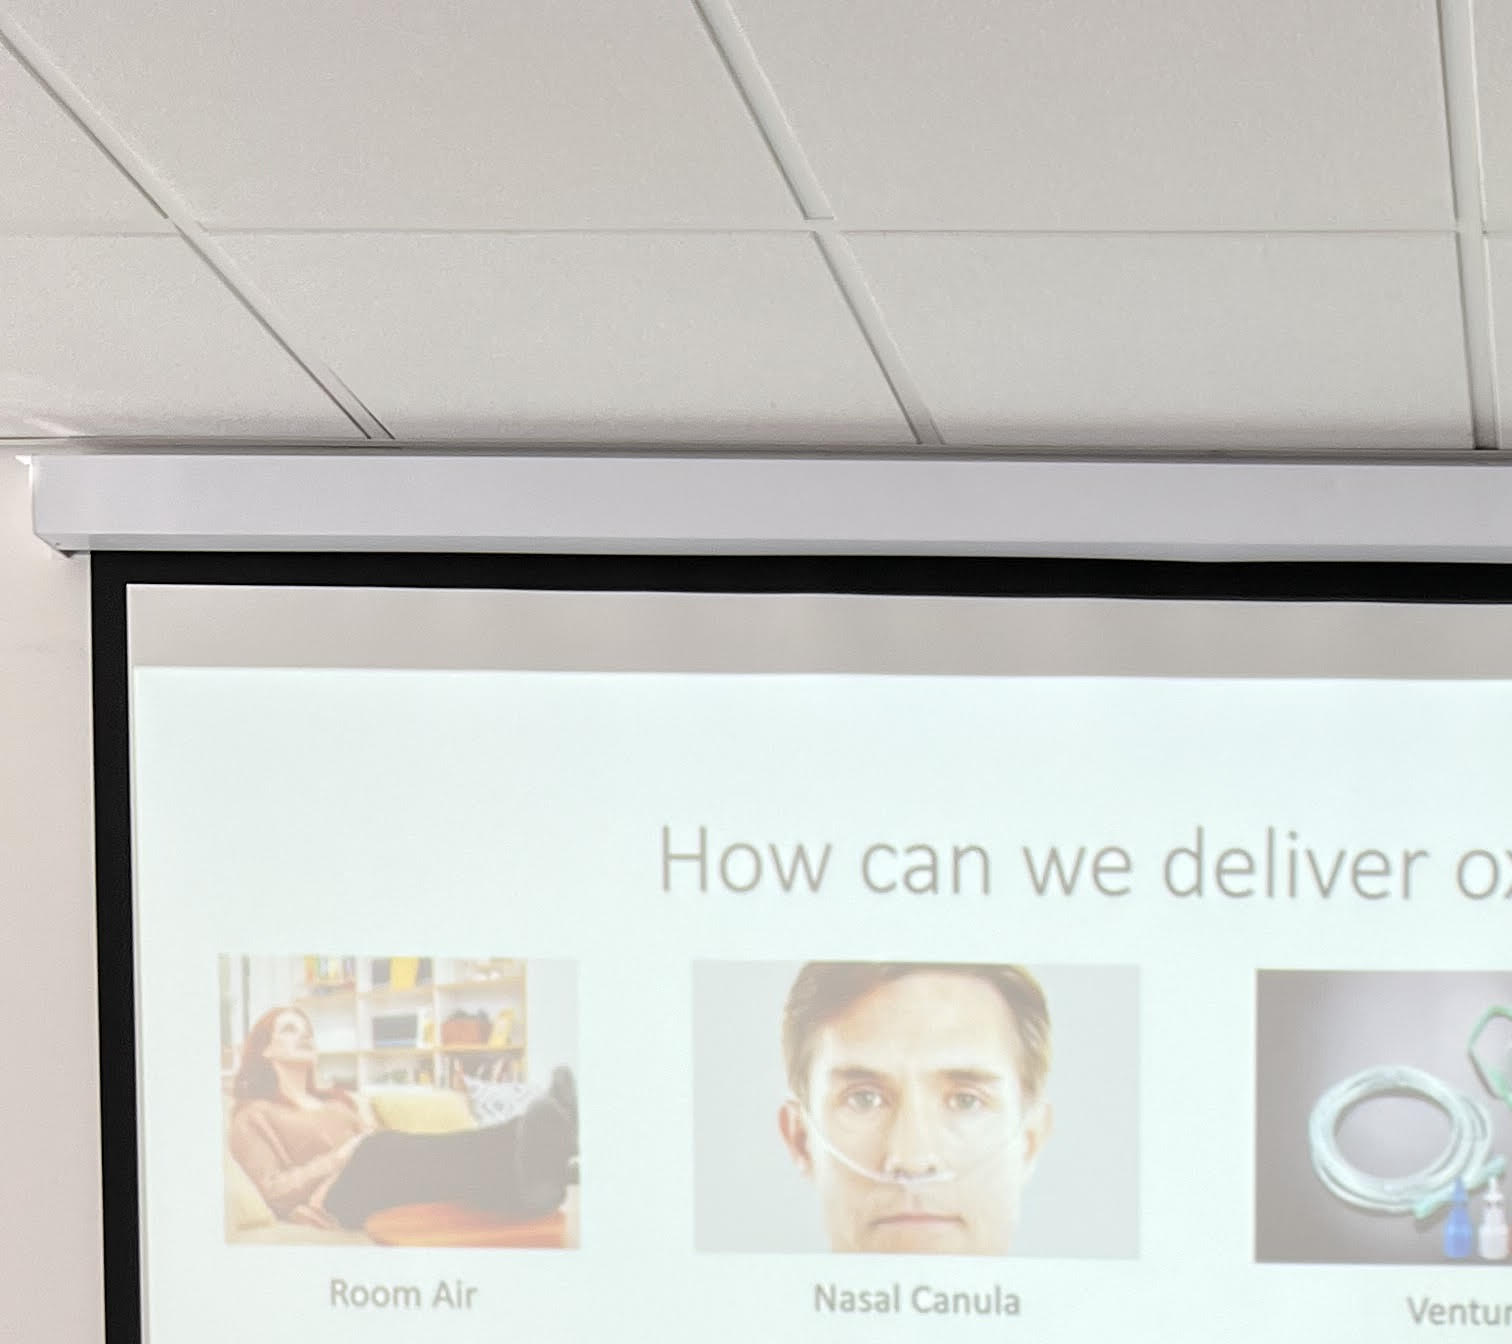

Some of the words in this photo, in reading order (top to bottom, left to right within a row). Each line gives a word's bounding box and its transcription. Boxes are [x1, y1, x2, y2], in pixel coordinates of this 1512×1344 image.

[660, 823, 835, 897] How
[858, 840, 993, 898] can
[1019, 843, 1135, 900] we
[1161, 823, 1432, 903] deliver
[328, 1276, 424, 1310] Room
[430, 1278, 480, 1311] Air
[812, 1281, 903, 1316] Nasal
[908, 1283, 1023, 1318] Canula
